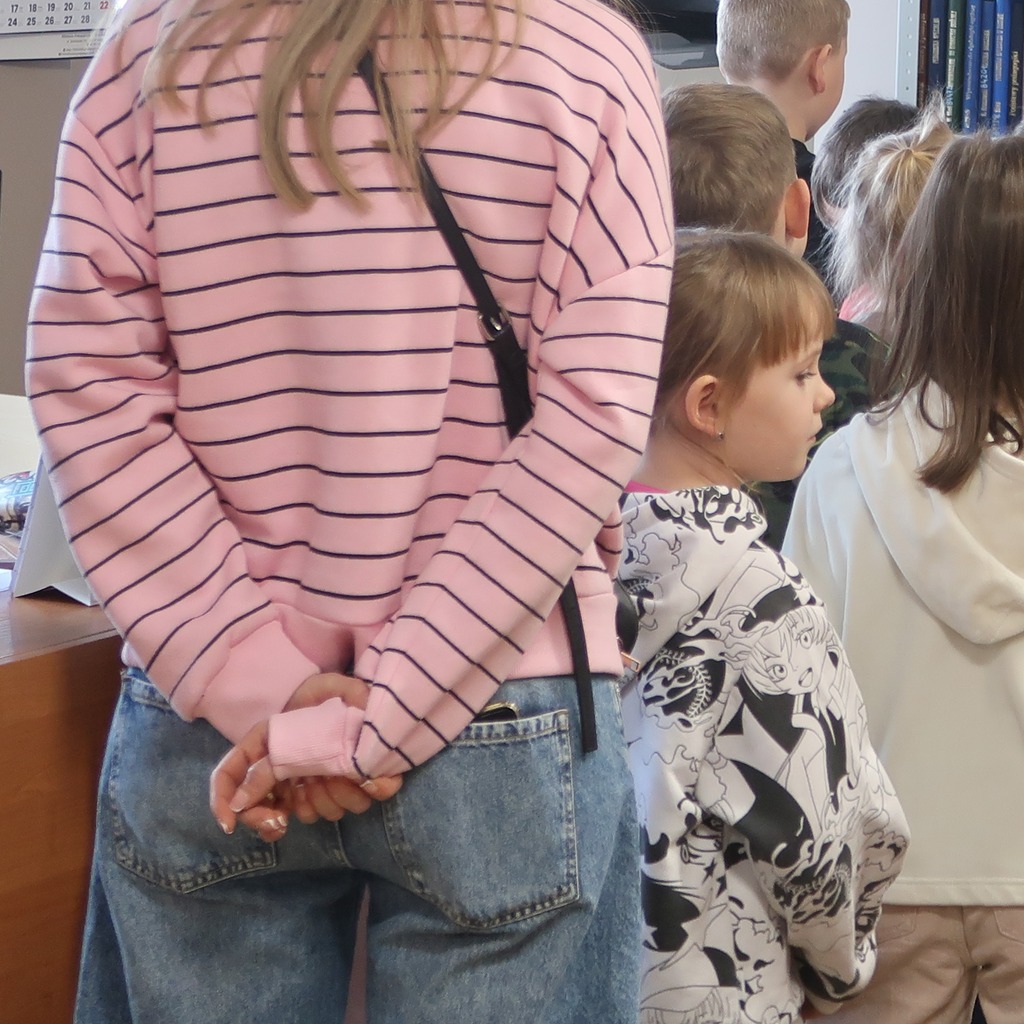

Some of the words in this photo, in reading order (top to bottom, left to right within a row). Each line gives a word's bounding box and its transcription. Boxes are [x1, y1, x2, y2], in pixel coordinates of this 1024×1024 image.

[11, 4, 18, 13] 17
[30, 4, 37, 12] 18
[48, 3, 55, 11] 19
[64, 2, 73, 11] 20
[8, 18, 17, 26] 24
[27, 17, 36, 26] 25
[45, 16, 54, 25] 26
[64, 16, 72, 24] 27
